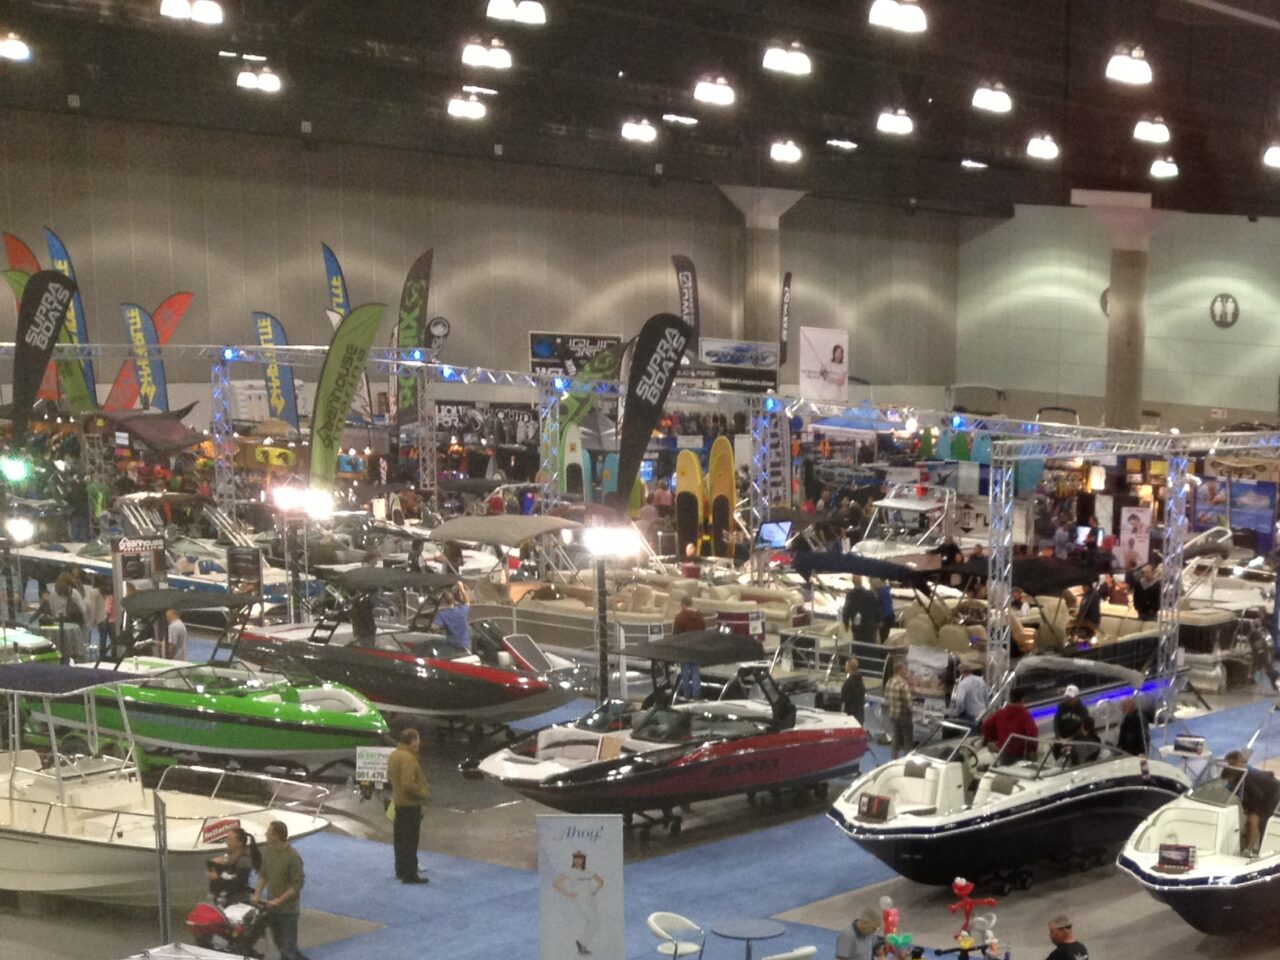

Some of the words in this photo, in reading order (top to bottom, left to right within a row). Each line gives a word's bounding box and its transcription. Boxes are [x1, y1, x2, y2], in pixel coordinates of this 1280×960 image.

[25, 282, 61, 346] SUPRA
[36, 288, 70, 350] BOATS
[635, 327, 680, 400] SUPRA
[647, 335, 686, 406] BOATS
